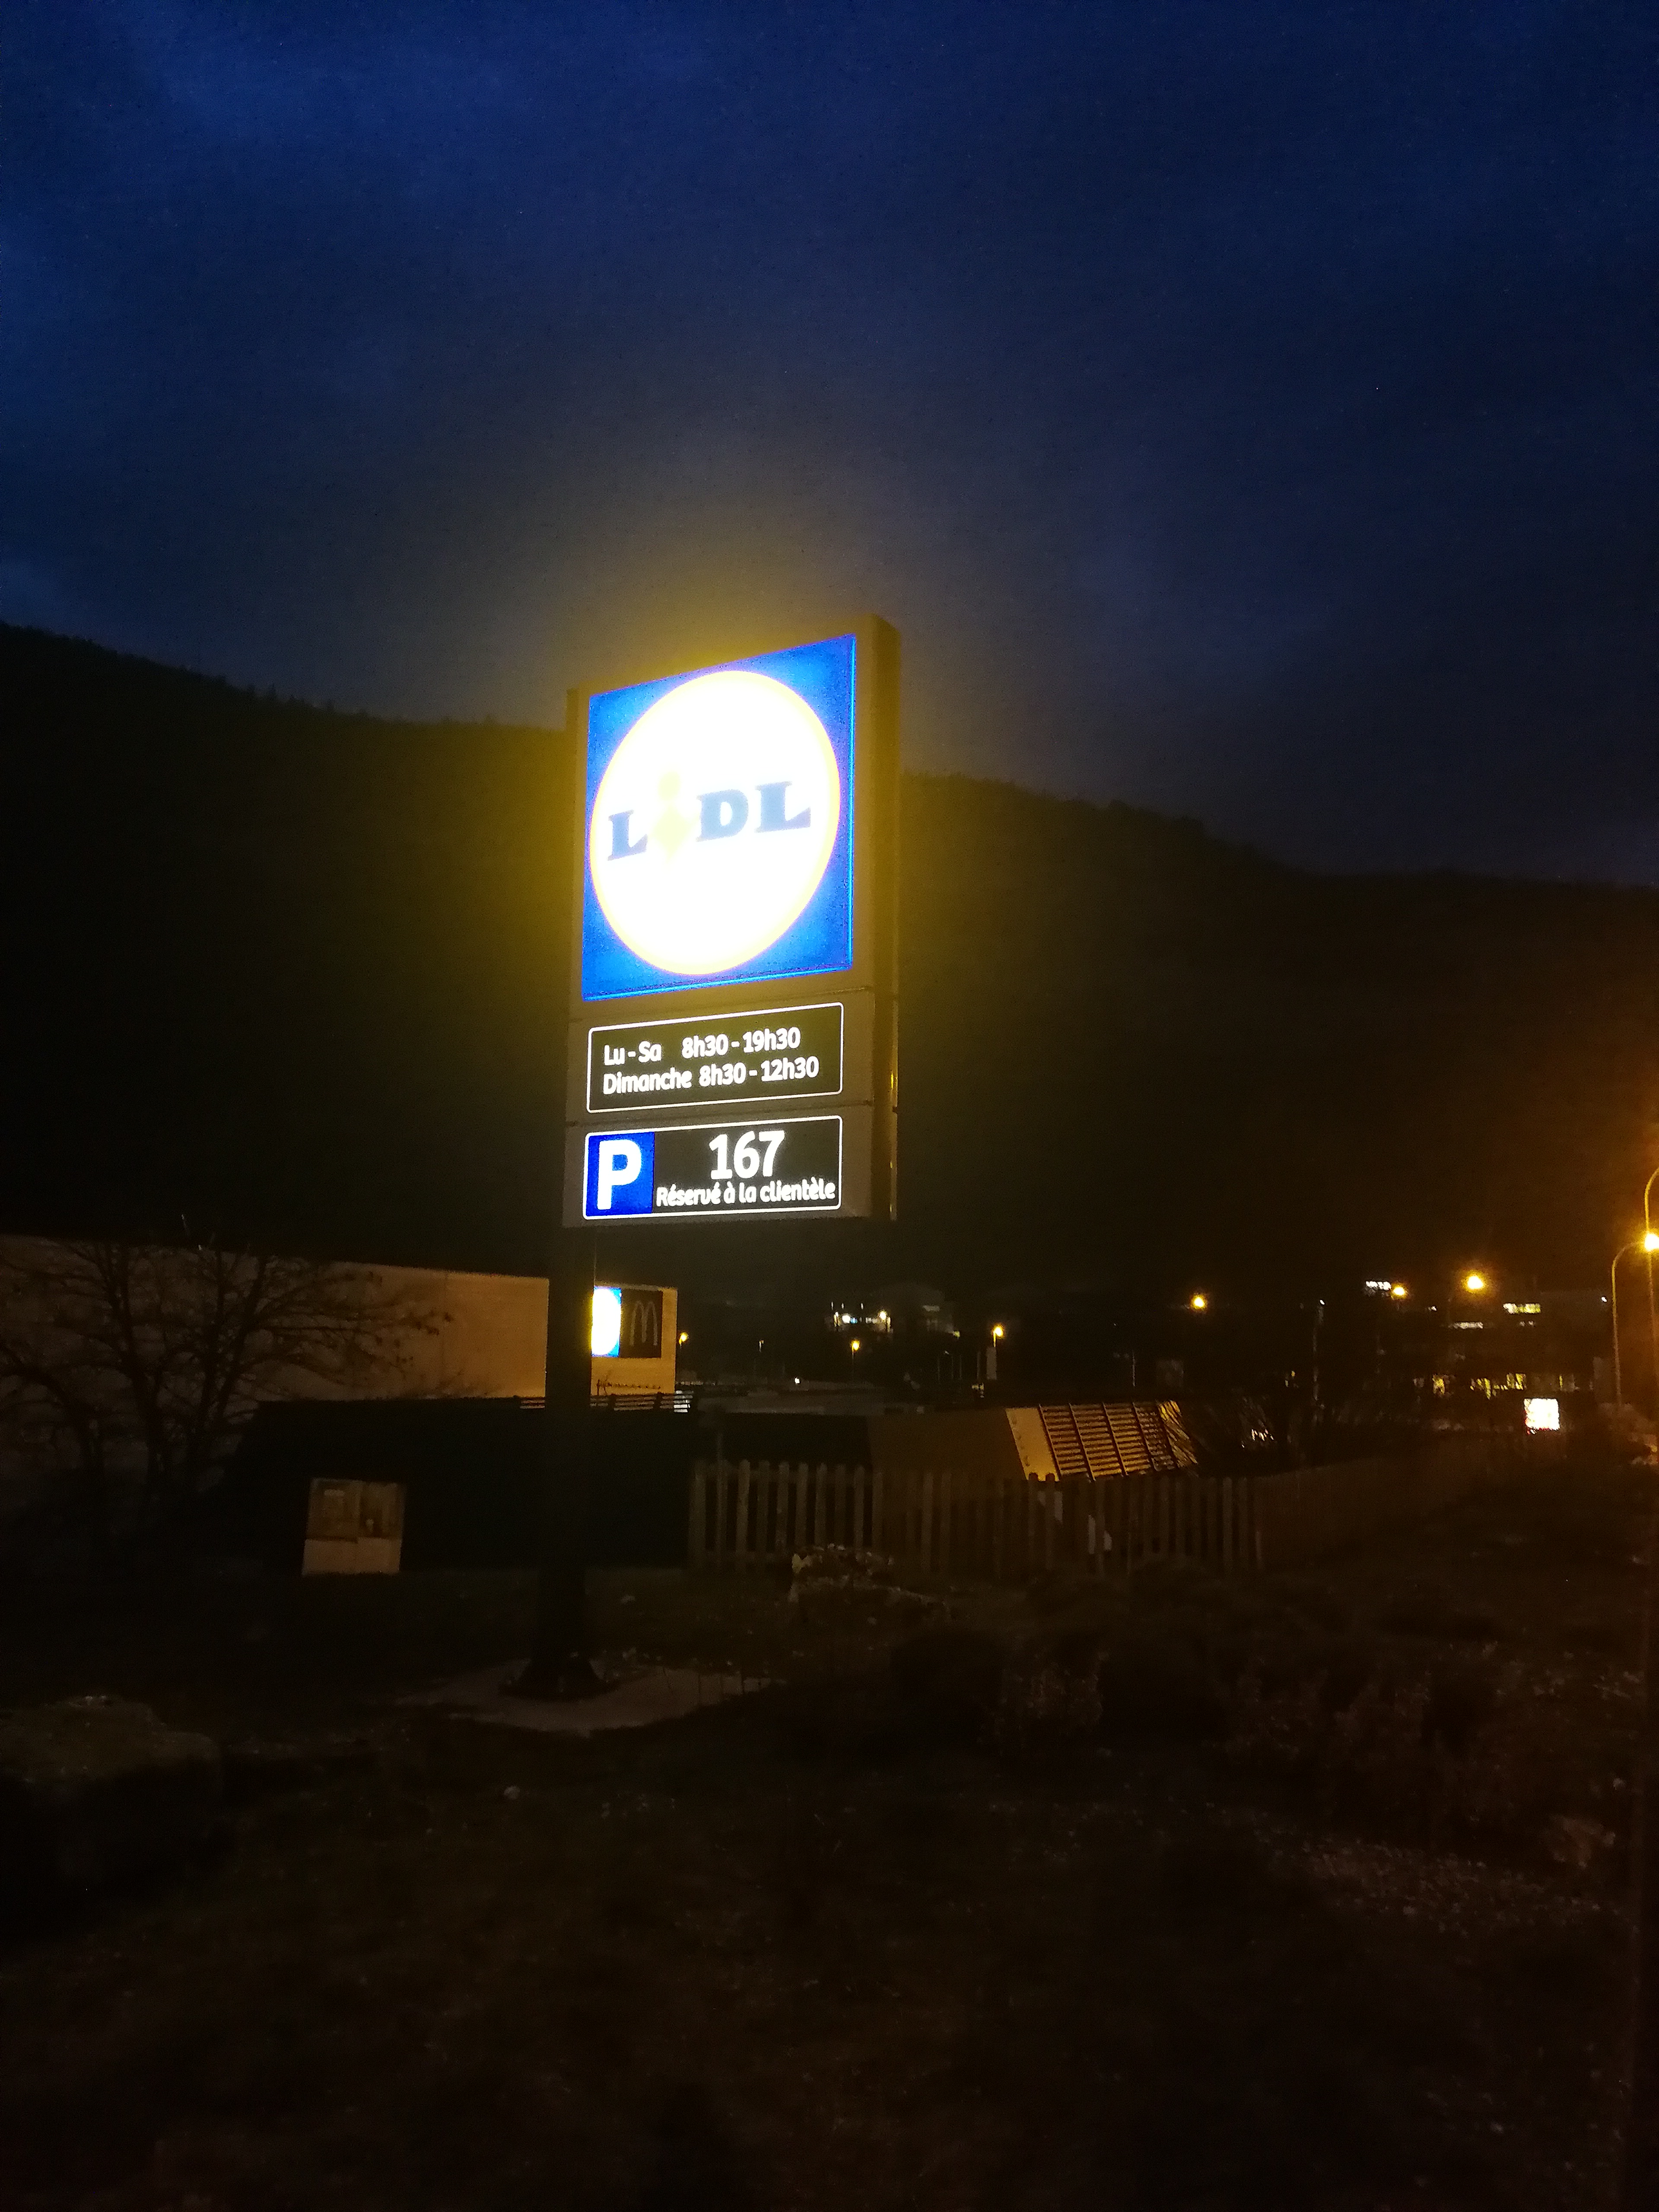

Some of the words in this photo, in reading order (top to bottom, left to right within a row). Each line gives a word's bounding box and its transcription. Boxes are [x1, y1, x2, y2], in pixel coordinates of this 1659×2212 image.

[604, 1045, 625, 1066] Lu
[638, 1041, 662, 1063] Sa
[681, 1034, 729, 1059] 8h30
[742, 1027, 801, 1053] 19h30
[603, 1067, 693, 1095] Dimanche
[699, 1062, 747, 1087] 8h30
[760, 1056, 819, 1082] 12h30
[597, 1139, 642, 1210] P
[709, 1130, 785, 1180] 167
[656, 1182, 721, 1207] Réservé
[723, 1181, 735, 1204] à
[739, 1182, 757, 1203] la
[760, 1176, 836, 1202] clientèle
